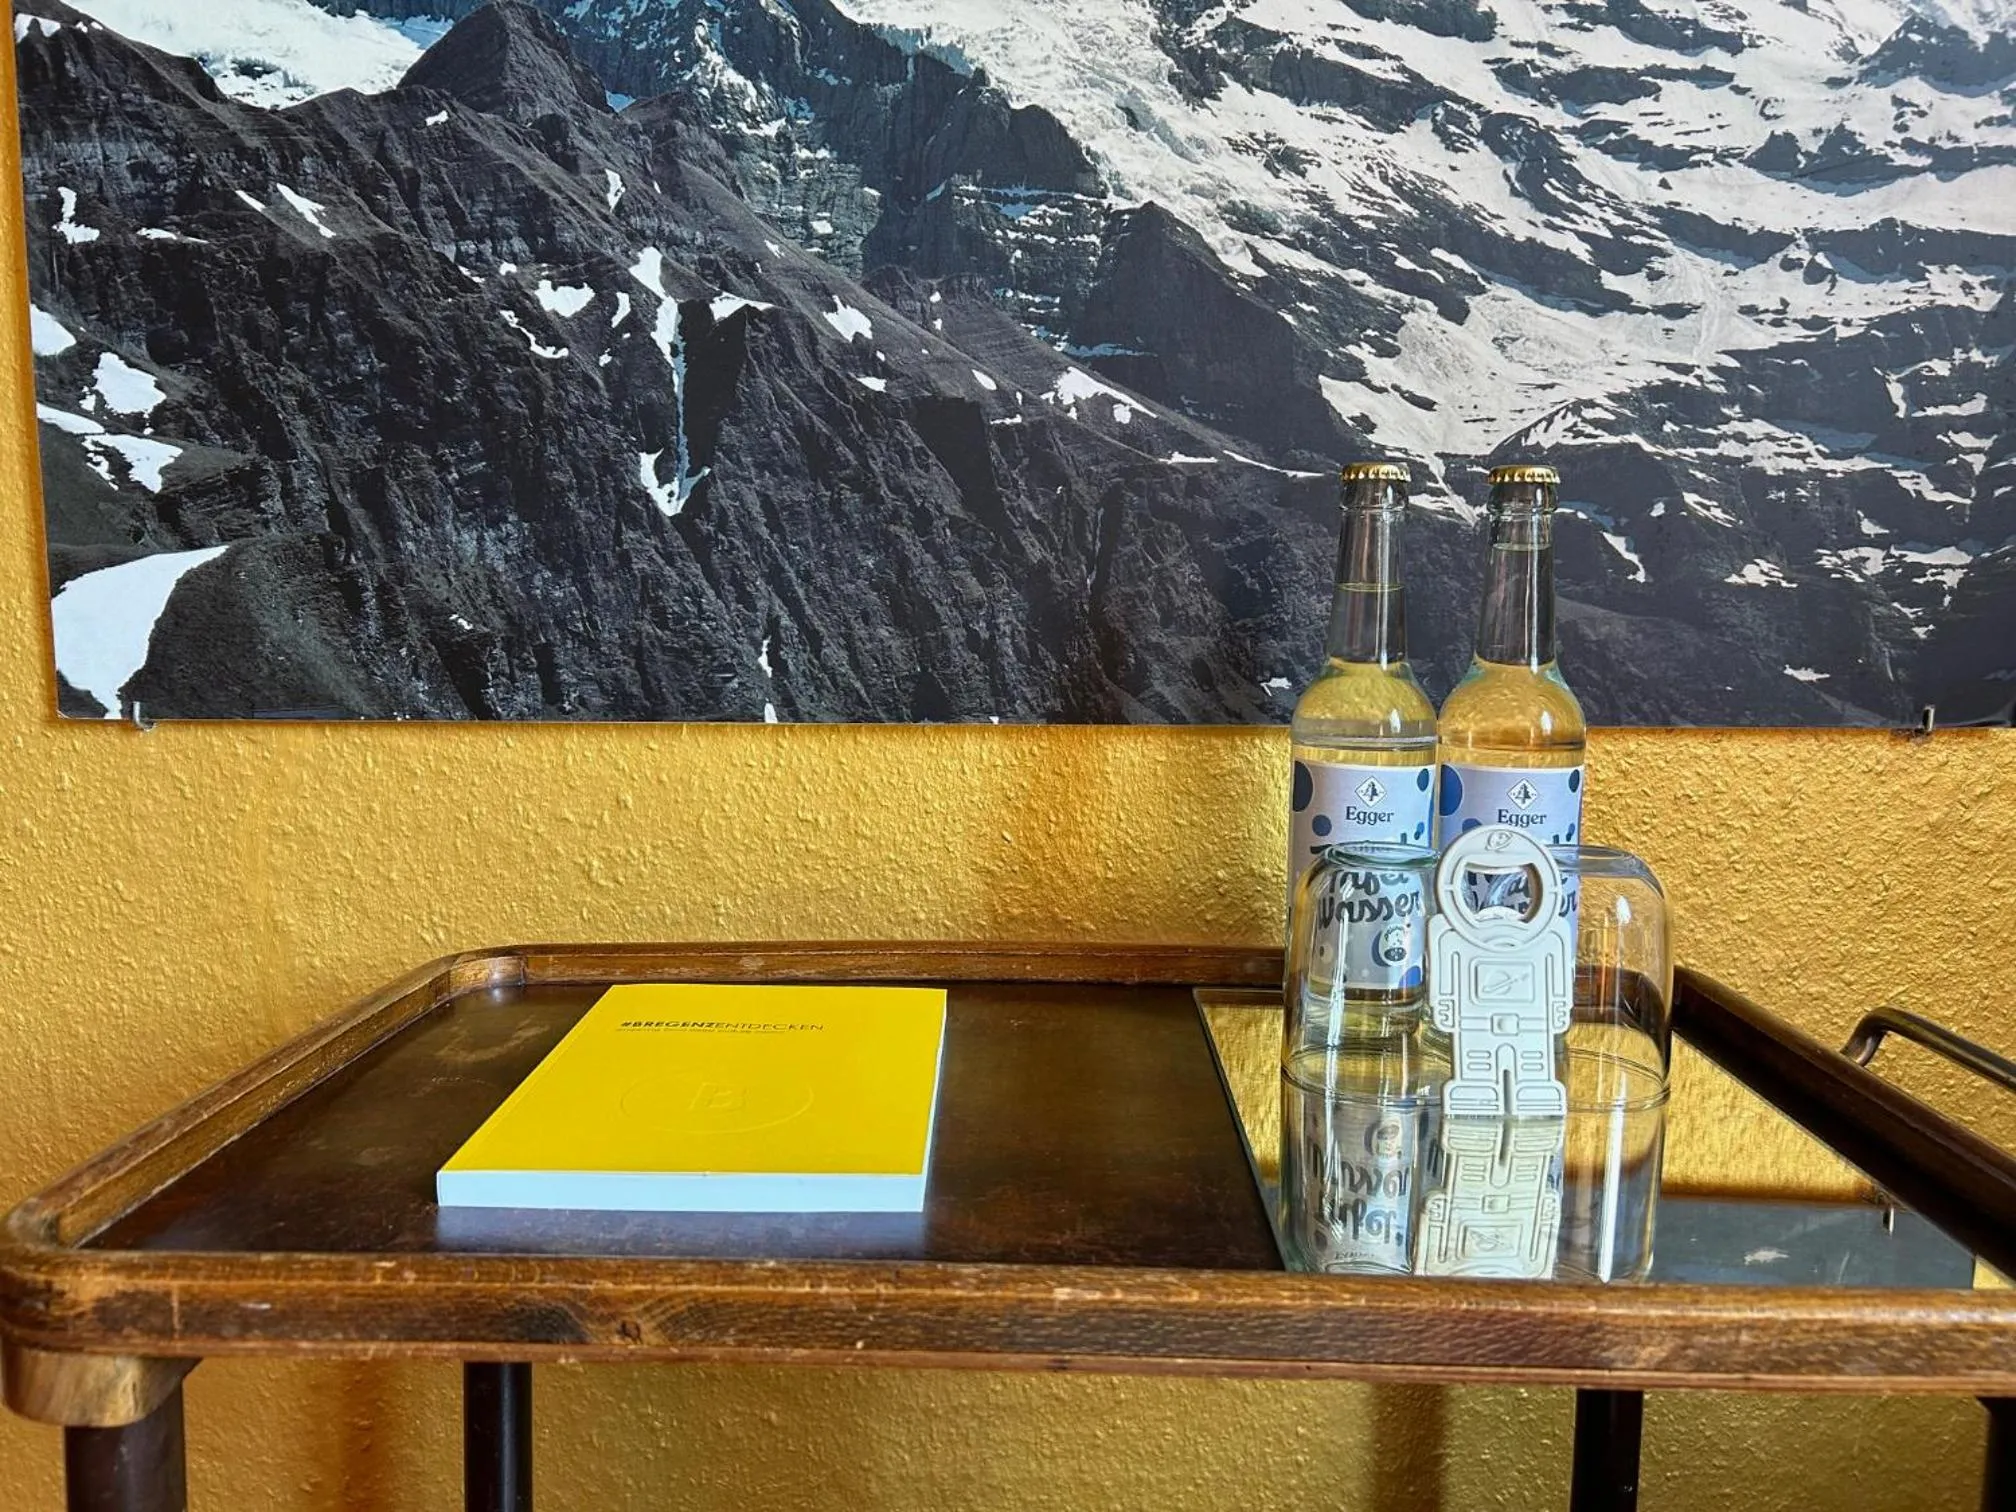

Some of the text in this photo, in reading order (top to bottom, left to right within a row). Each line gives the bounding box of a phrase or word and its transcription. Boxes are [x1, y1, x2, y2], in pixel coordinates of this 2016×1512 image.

[1345, 805, 1395, 826] Egger
[1497, 808, 1548, 827] Egger
[1318, 891, 1421, 930] Wasser
[621, 1021, 824, 1031] #BREGENZENTDECKEN
